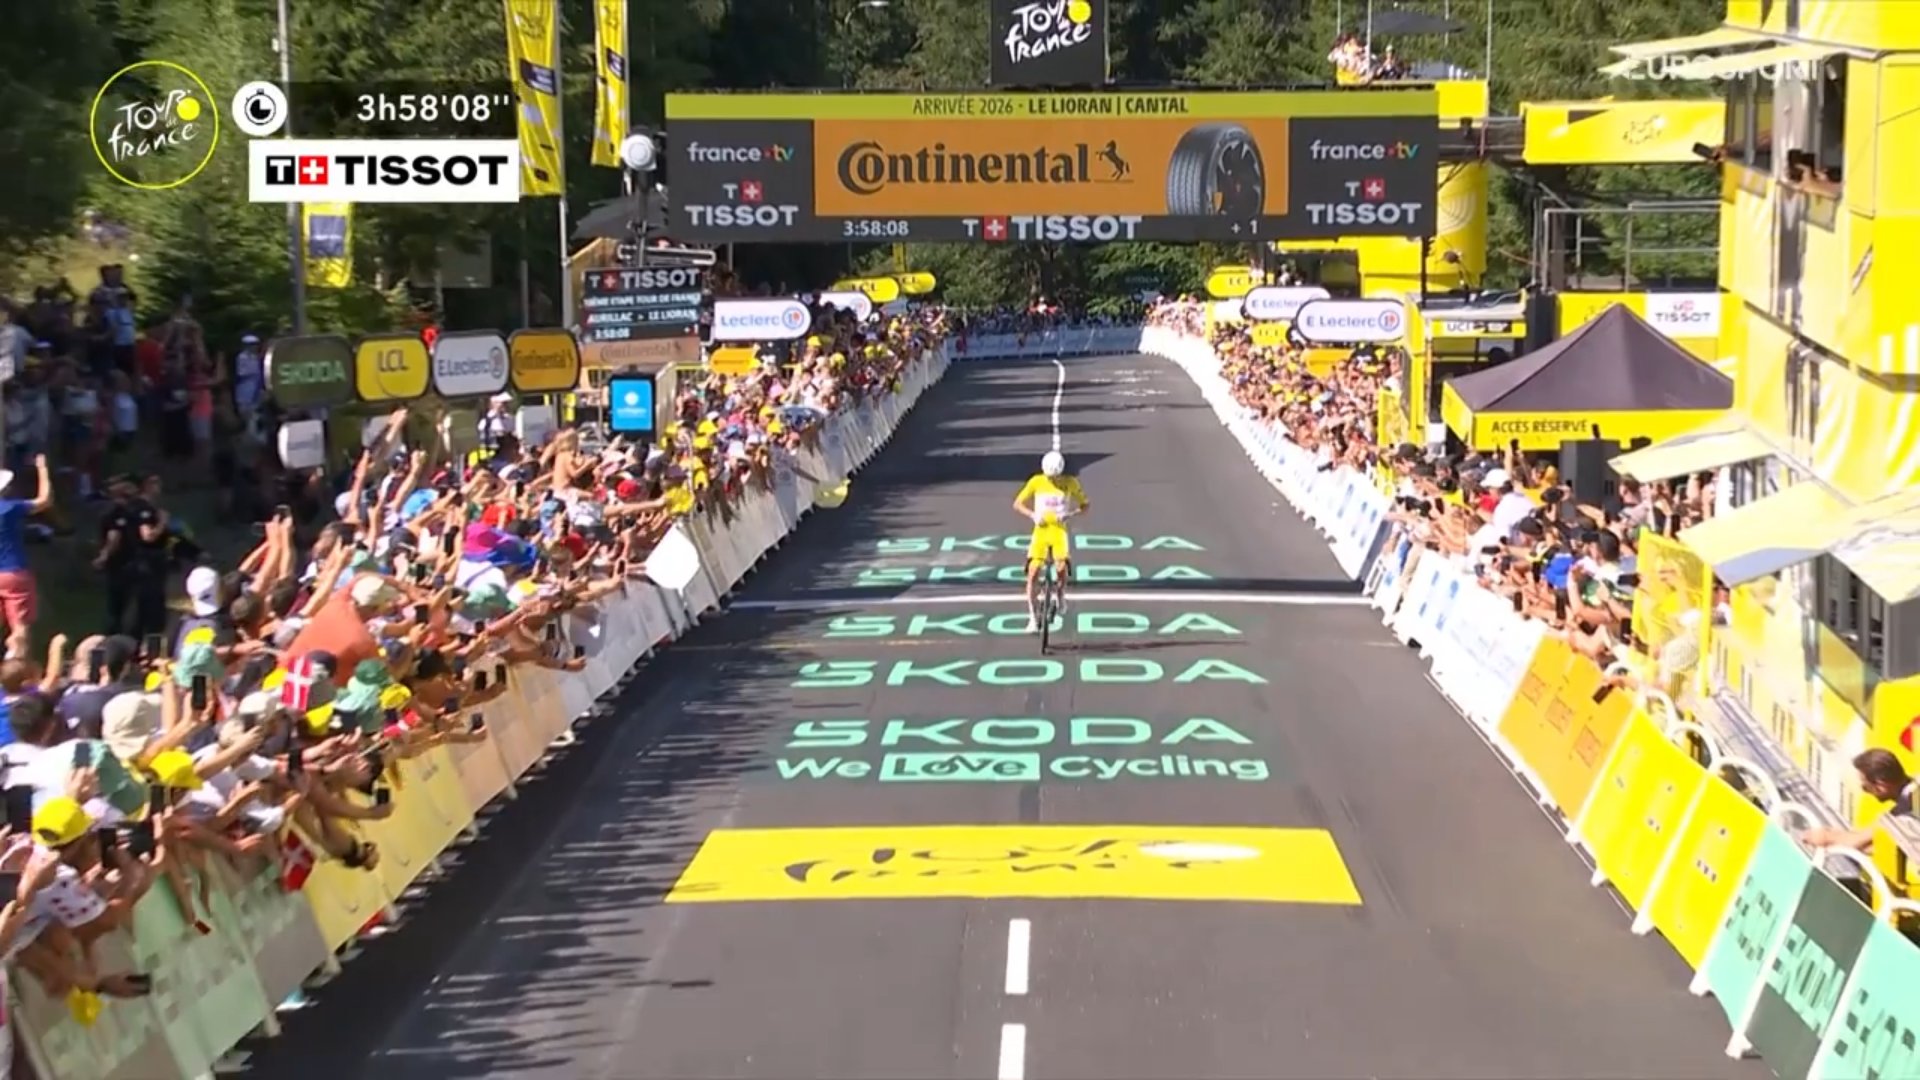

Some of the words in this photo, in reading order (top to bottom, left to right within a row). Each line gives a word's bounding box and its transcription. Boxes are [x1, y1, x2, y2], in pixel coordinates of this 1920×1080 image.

[913, 94, 975, 115] ARRIVÉE
[980, 98, 1014, 115] 2026
[1028, 98, 1047, 114] LE
[1051, 97, 1112, 114] LIORAN
[1125, 97, 1189, 114] CANTAL
[837, 139, 1091, 195] Continental
[685, 204, 798, 226] TISSOT
[1305, 202, 1422, 224] TISSOT
[843, 219, 909, 236] 3:58:08
[1011, 215, 1142, 241] TISSOT
[620, 268, 699, 289] TISSOT
[1655, 312, 1711, 323] TISSOT
[378, 350, 410, 373] LCL
[775, 758, 872, 780] We
[892, 755, 1027, 777] Love
[1050, 755, 1270, 781] Cycling
